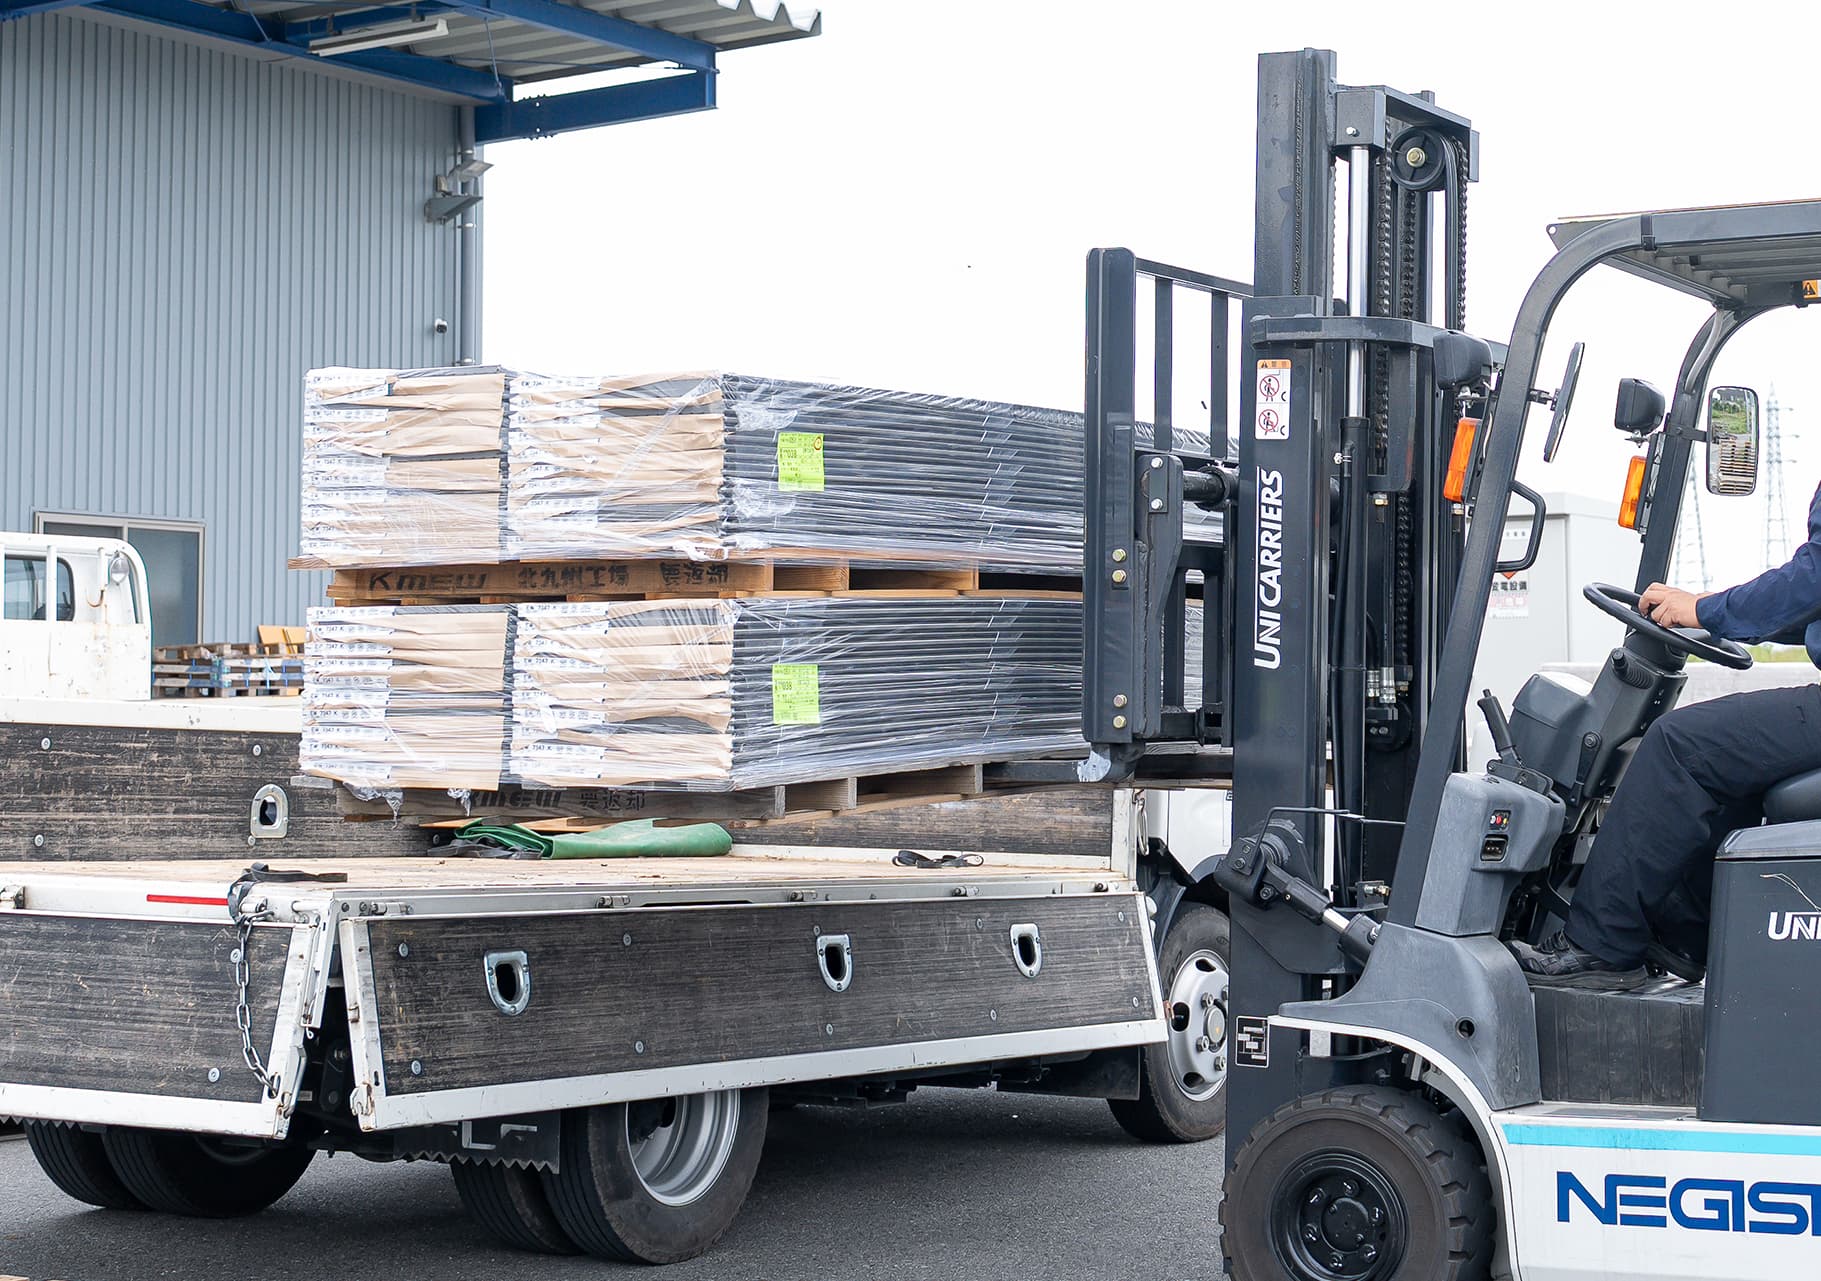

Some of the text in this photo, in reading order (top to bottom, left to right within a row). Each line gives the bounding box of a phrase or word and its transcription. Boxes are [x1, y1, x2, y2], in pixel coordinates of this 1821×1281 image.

[517, 564, 630, 589] 北九州工場
[1254, 466, 1284, 670] UNICARRIERS
